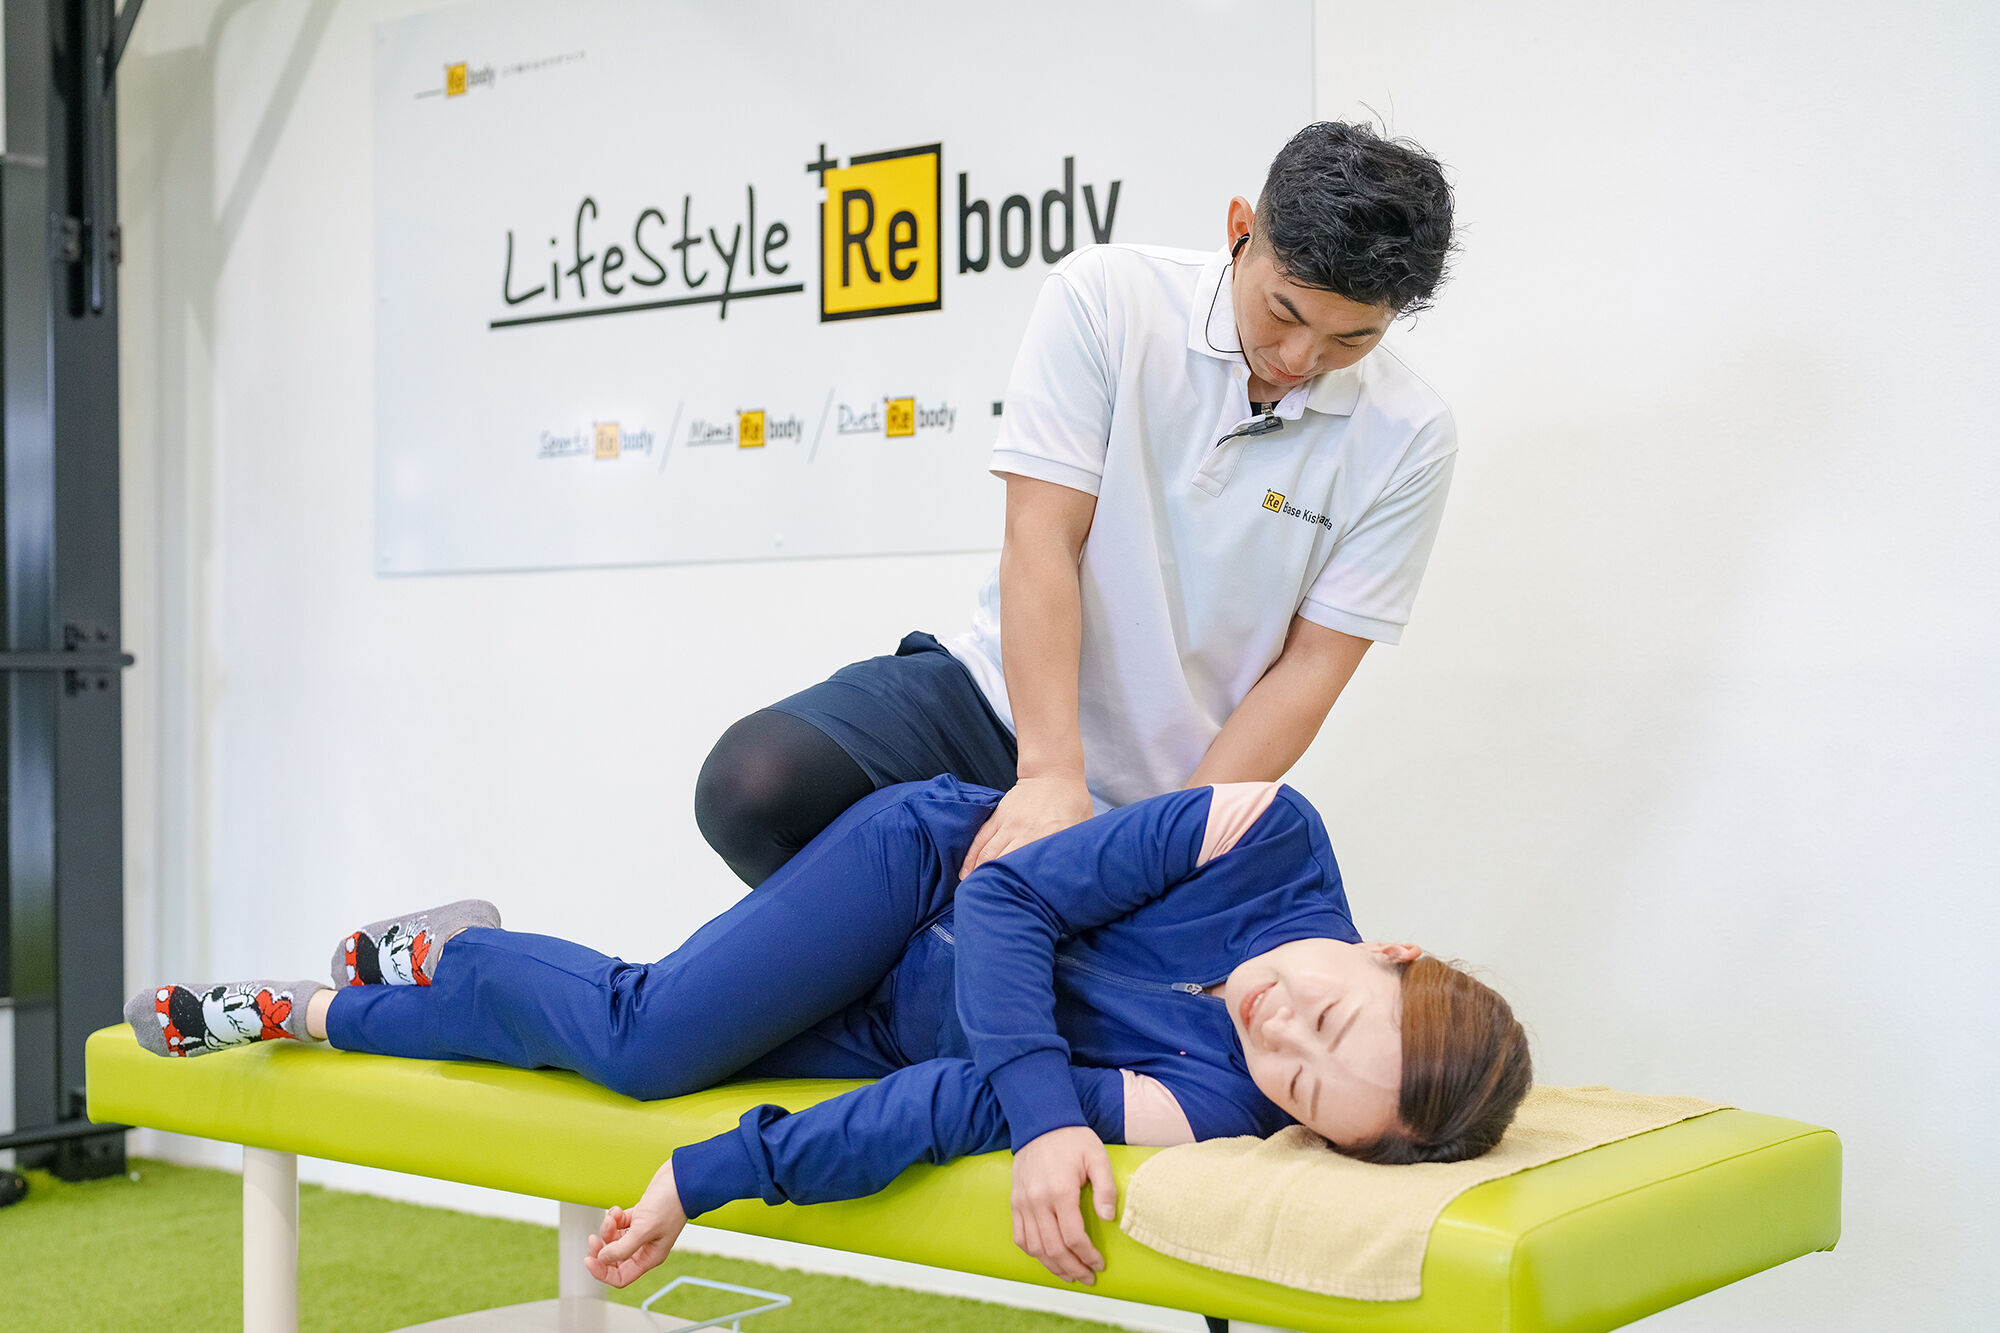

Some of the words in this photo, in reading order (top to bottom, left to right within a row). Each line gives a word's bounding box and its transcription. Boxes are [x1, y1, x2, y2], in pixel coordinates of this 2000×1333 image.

[505, 184, 790, 320] LifeStyle
[841, 188, 919, 288] Re
[768, 414, 803, 445] body
[889, 404, 909, 429] Re
[919, 402, 956, 433] body
[622, 428, 654, 457] body
[1266, 494, 1280, 508] Re
[1283, 501, 1301, 518] Base
